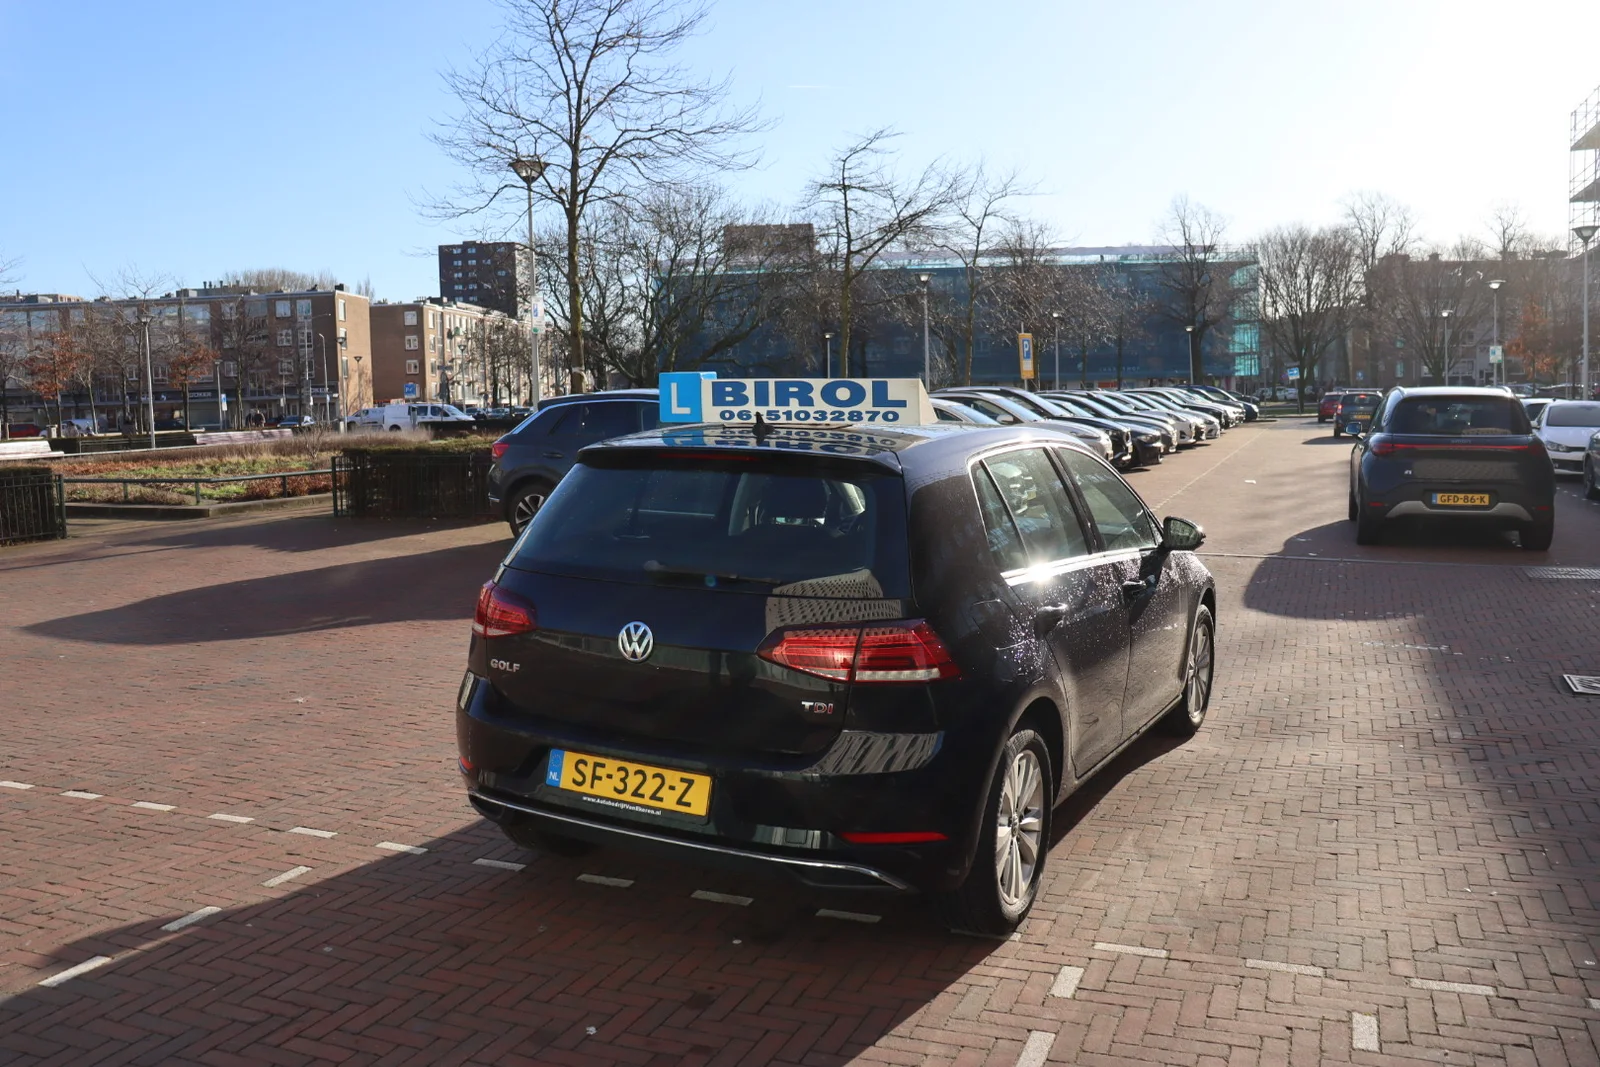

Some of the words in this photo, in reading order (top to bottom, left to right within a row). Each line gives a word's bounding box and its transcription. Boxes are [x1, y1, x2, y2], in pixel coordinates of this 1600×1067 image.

[670, 382, 691, 415] L
[711, 380, 907, 408] BIROL
[1440, 494, 1486, 504] GFD-86-K
[490, 658, 520, 673] GOLF
[801, 700, 834, 714] TDI
[548, 771, 559, 781] NL
[572, 758, 695, 808] SF-322-Z
